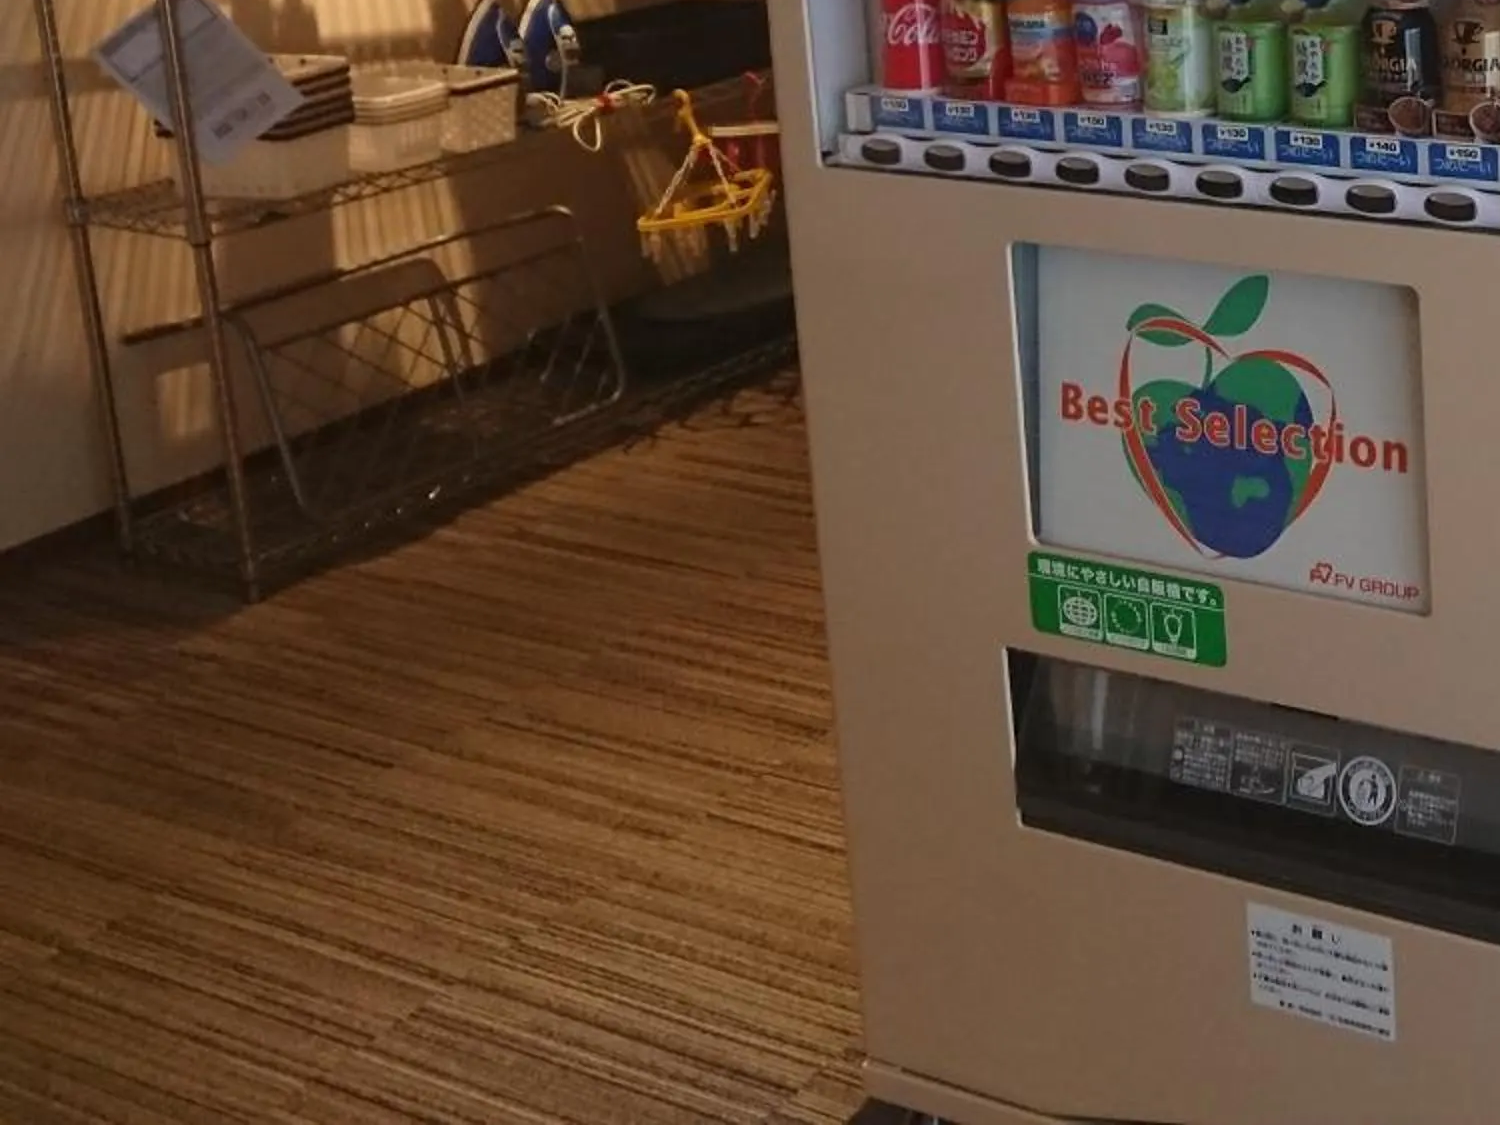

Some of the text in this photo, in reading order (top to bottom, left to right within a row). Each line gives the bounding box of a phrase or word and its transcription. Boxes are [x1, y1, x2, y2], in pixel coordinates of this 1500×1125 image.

[1060, 381, 1409, 474] Best Selection
[1334, 572, 1420, 600] FV GROUP
